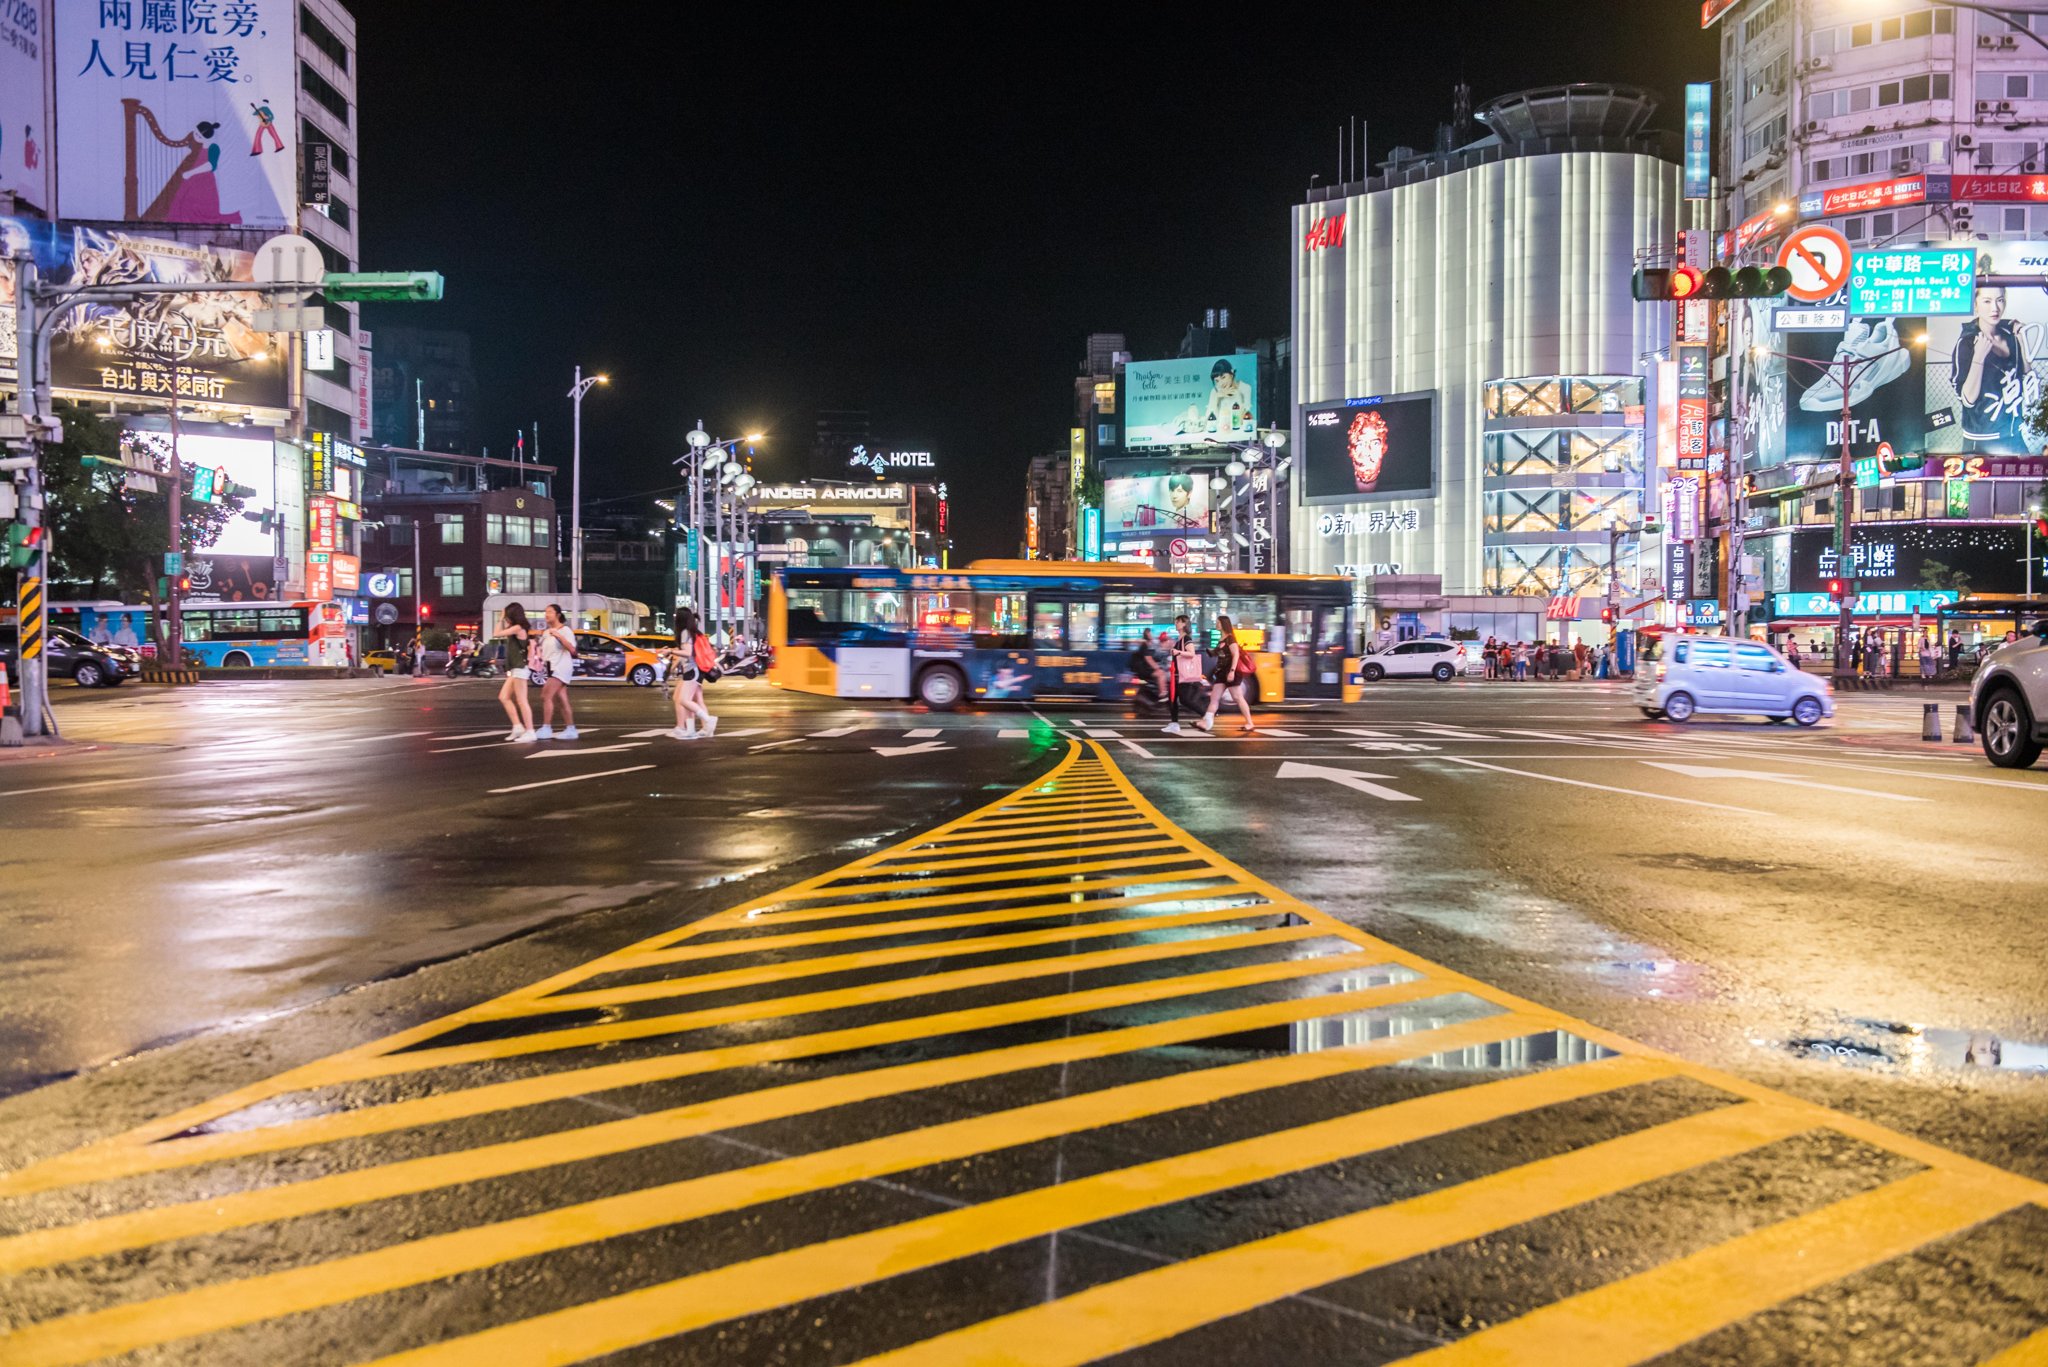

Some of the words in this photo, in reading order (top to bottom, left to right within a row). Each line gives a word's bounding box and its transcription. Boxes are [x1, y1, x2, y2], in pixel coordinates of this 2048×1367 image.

[1894, 182, 1921, 193] HOTEL
[1304, 213, 1346, 252] H&M
[1867, 254, 1960, 273] 中華路一段
[1780, 312, 1842, 325] 公車除外
[101, 367, 136, 390] 台北
[1347, 396, 1382, 406] Panasonic
[890, 452, 935, 467] HOTEL
[1073, 458, 1083, 489] HOTE
[821, 487, 903, 499] ARMOUR
[1335, 509, 1419, 534] 新世界大樓
[1858, 569, 1895, 577] TOUCH
[1547, 596, 1581, 618] H&M
[1381, 615, 1391, 631] 6
